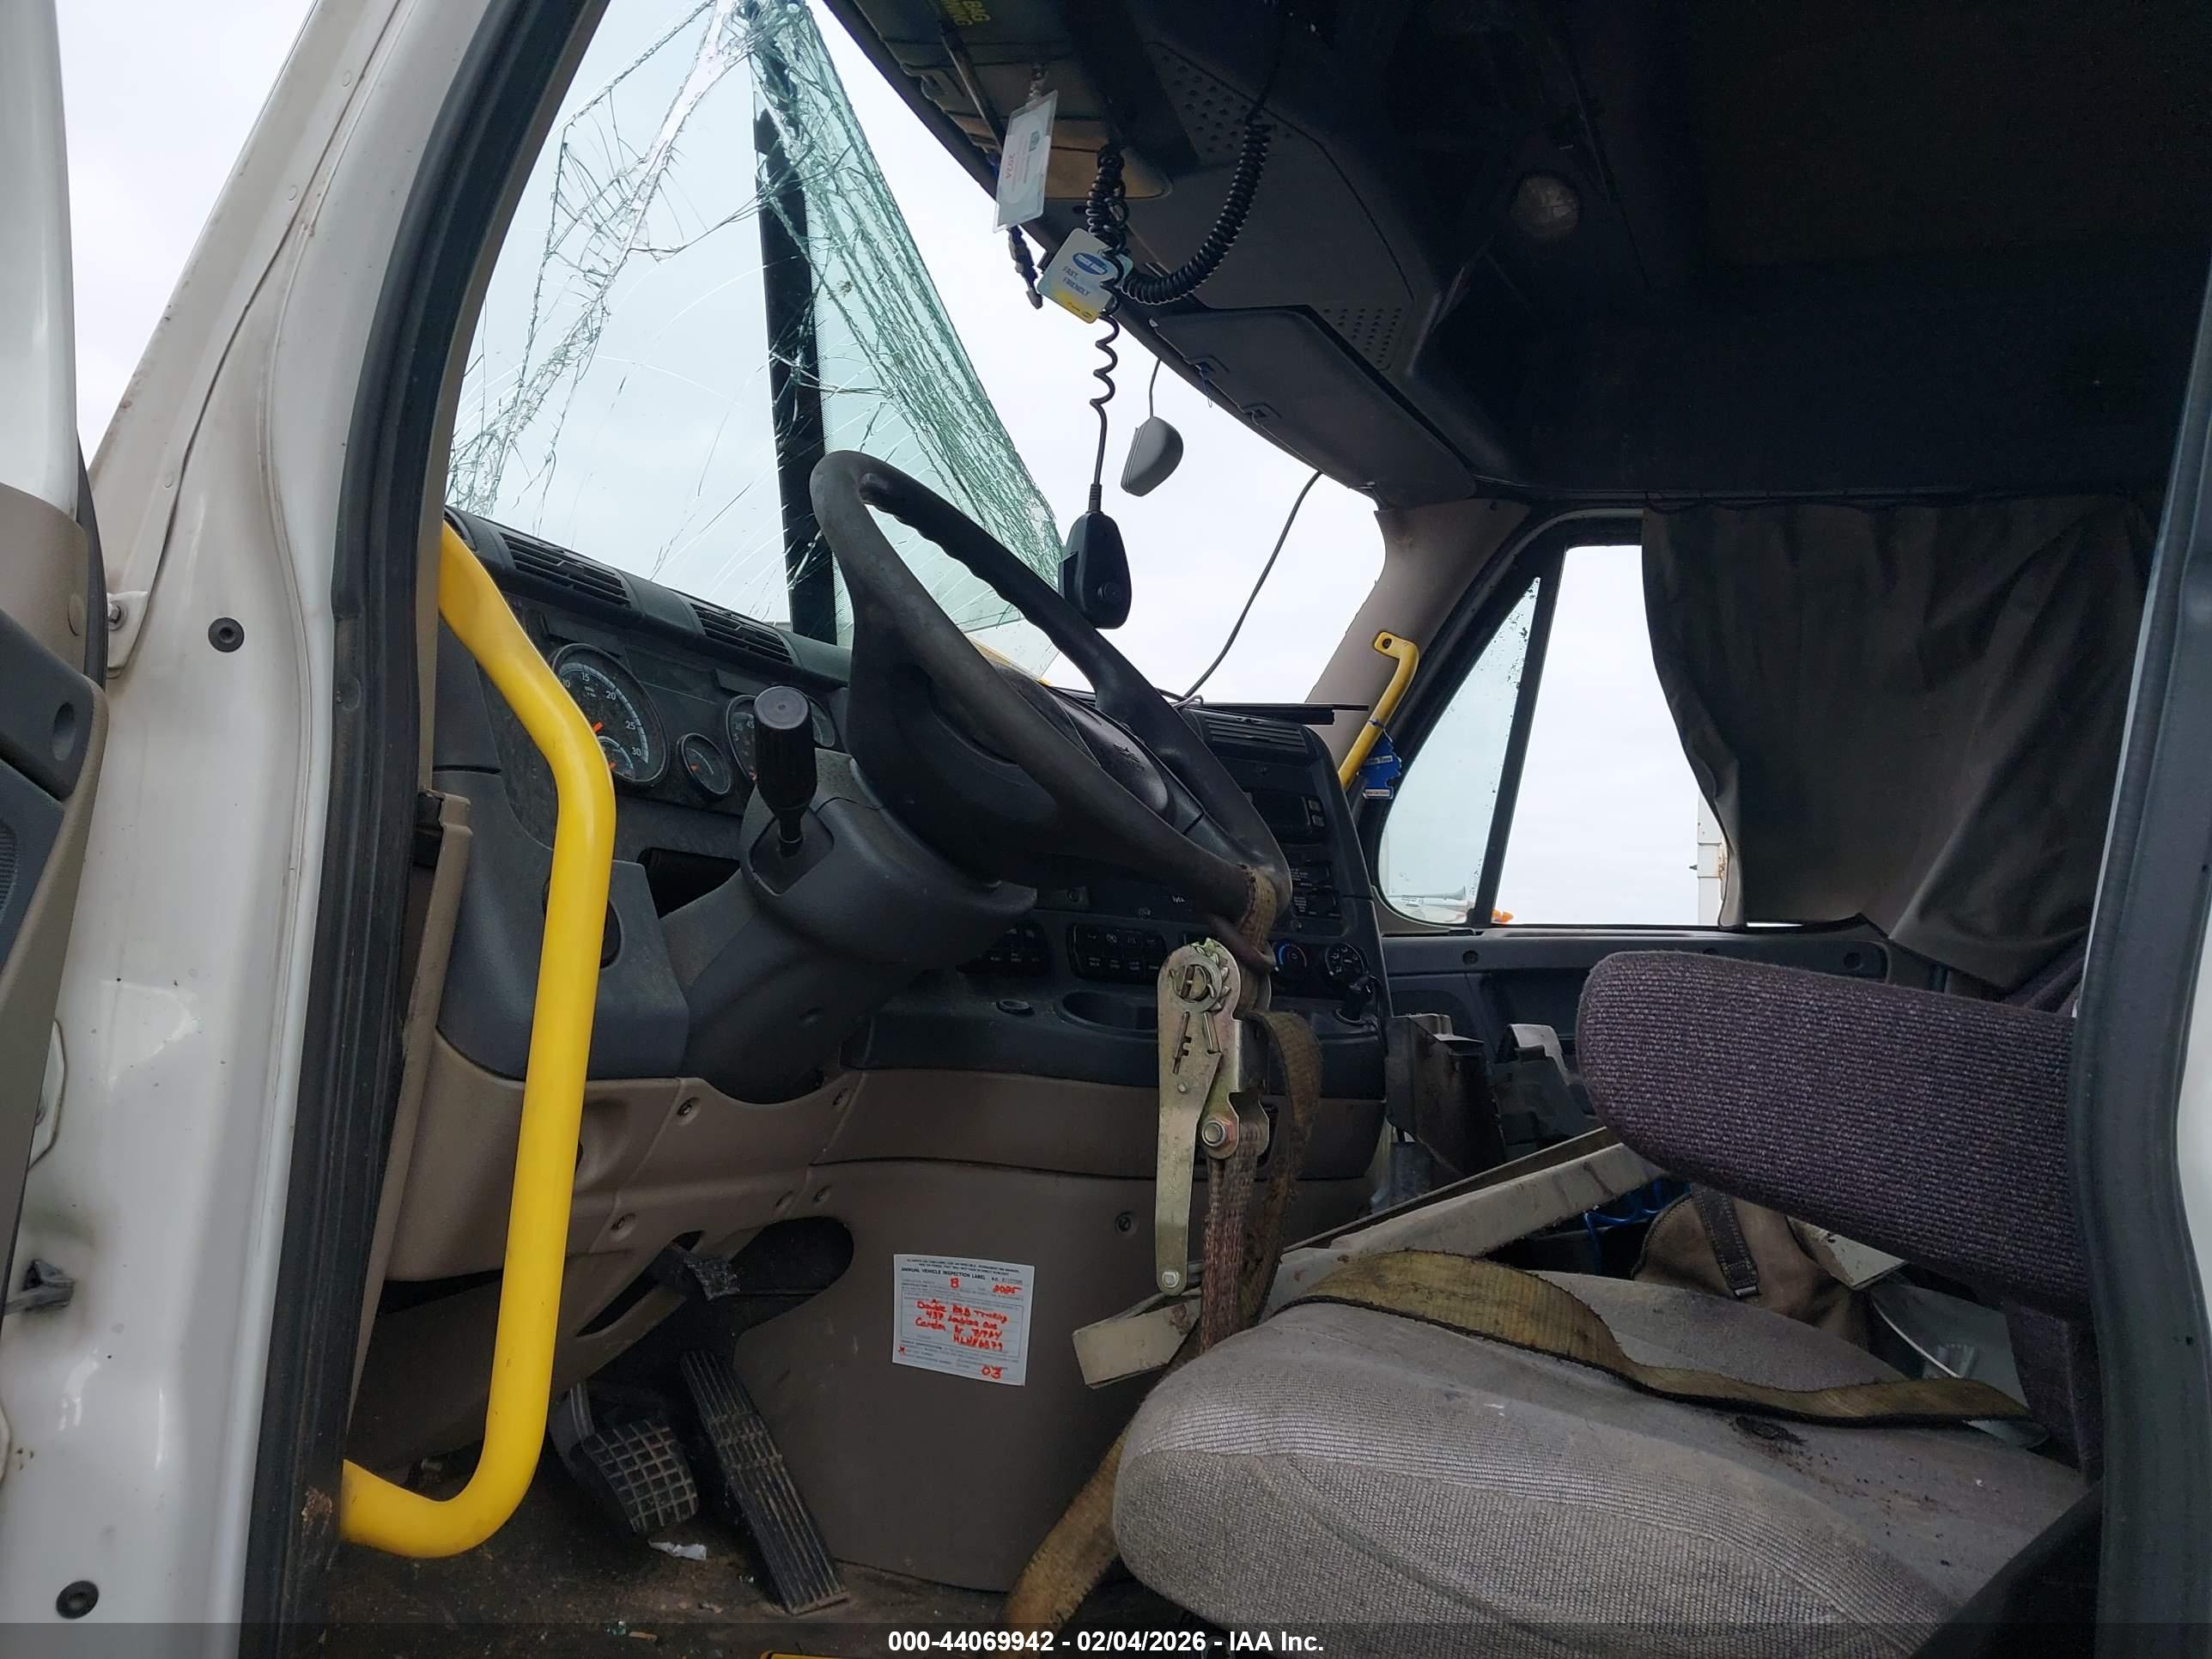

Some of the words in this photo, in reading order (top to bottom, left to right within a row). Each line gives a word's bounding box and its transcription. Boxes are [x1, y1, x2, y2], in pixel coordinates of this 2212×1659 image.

[581, 672, 590, 682] 15
[562, 678, 571, 688] 10
[605, 690, 617, 701] 20
[625, 720, 635, 731] 25
[631, 746, 641, 757] 30
[943, 1270, 969, 1279] INSPECTION
